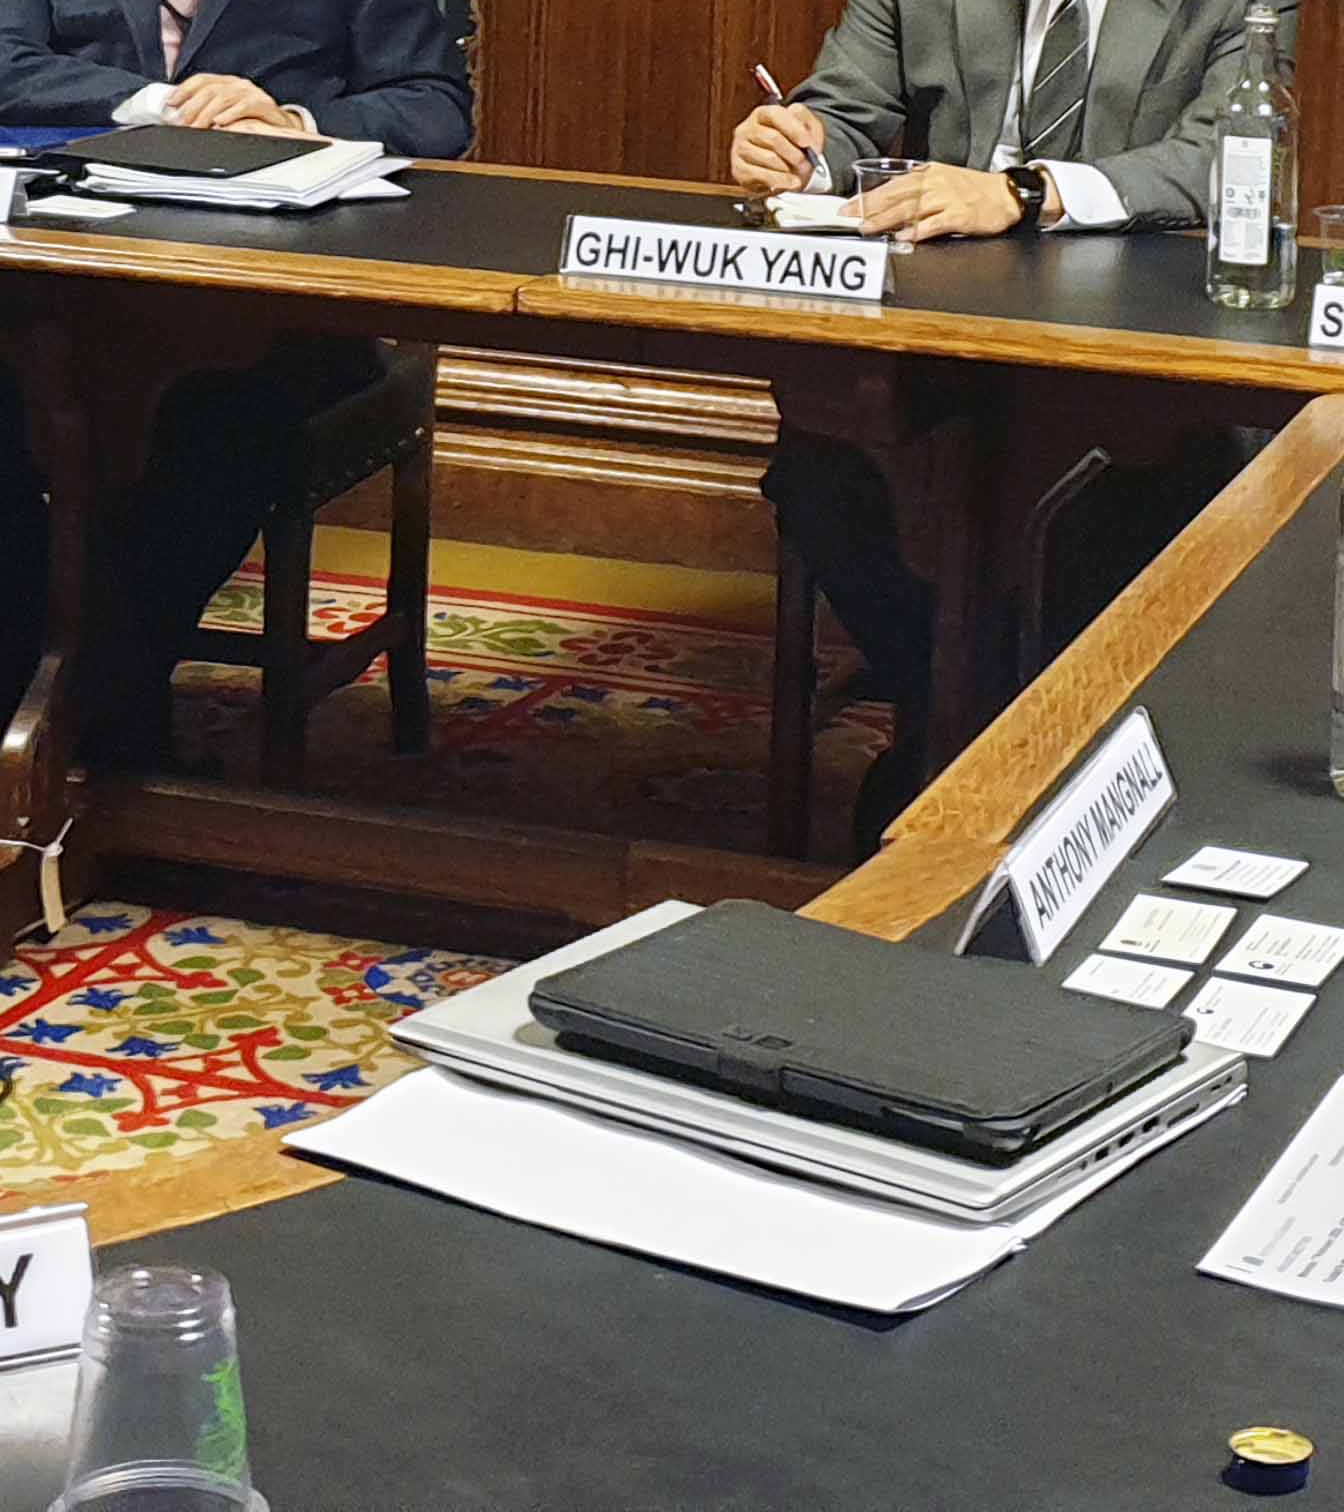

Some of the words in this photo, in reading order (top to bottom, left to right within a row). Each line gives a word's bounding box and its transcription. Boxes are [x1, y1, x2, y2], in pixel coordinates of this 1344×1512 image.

[576, 232, 748, 280] GHI-WUK
[760, 247, 867, 291] YANG
[1029, 813, 1099, 929] ANTHONY
[1089, 742, 1163, 850] MANGNALL
